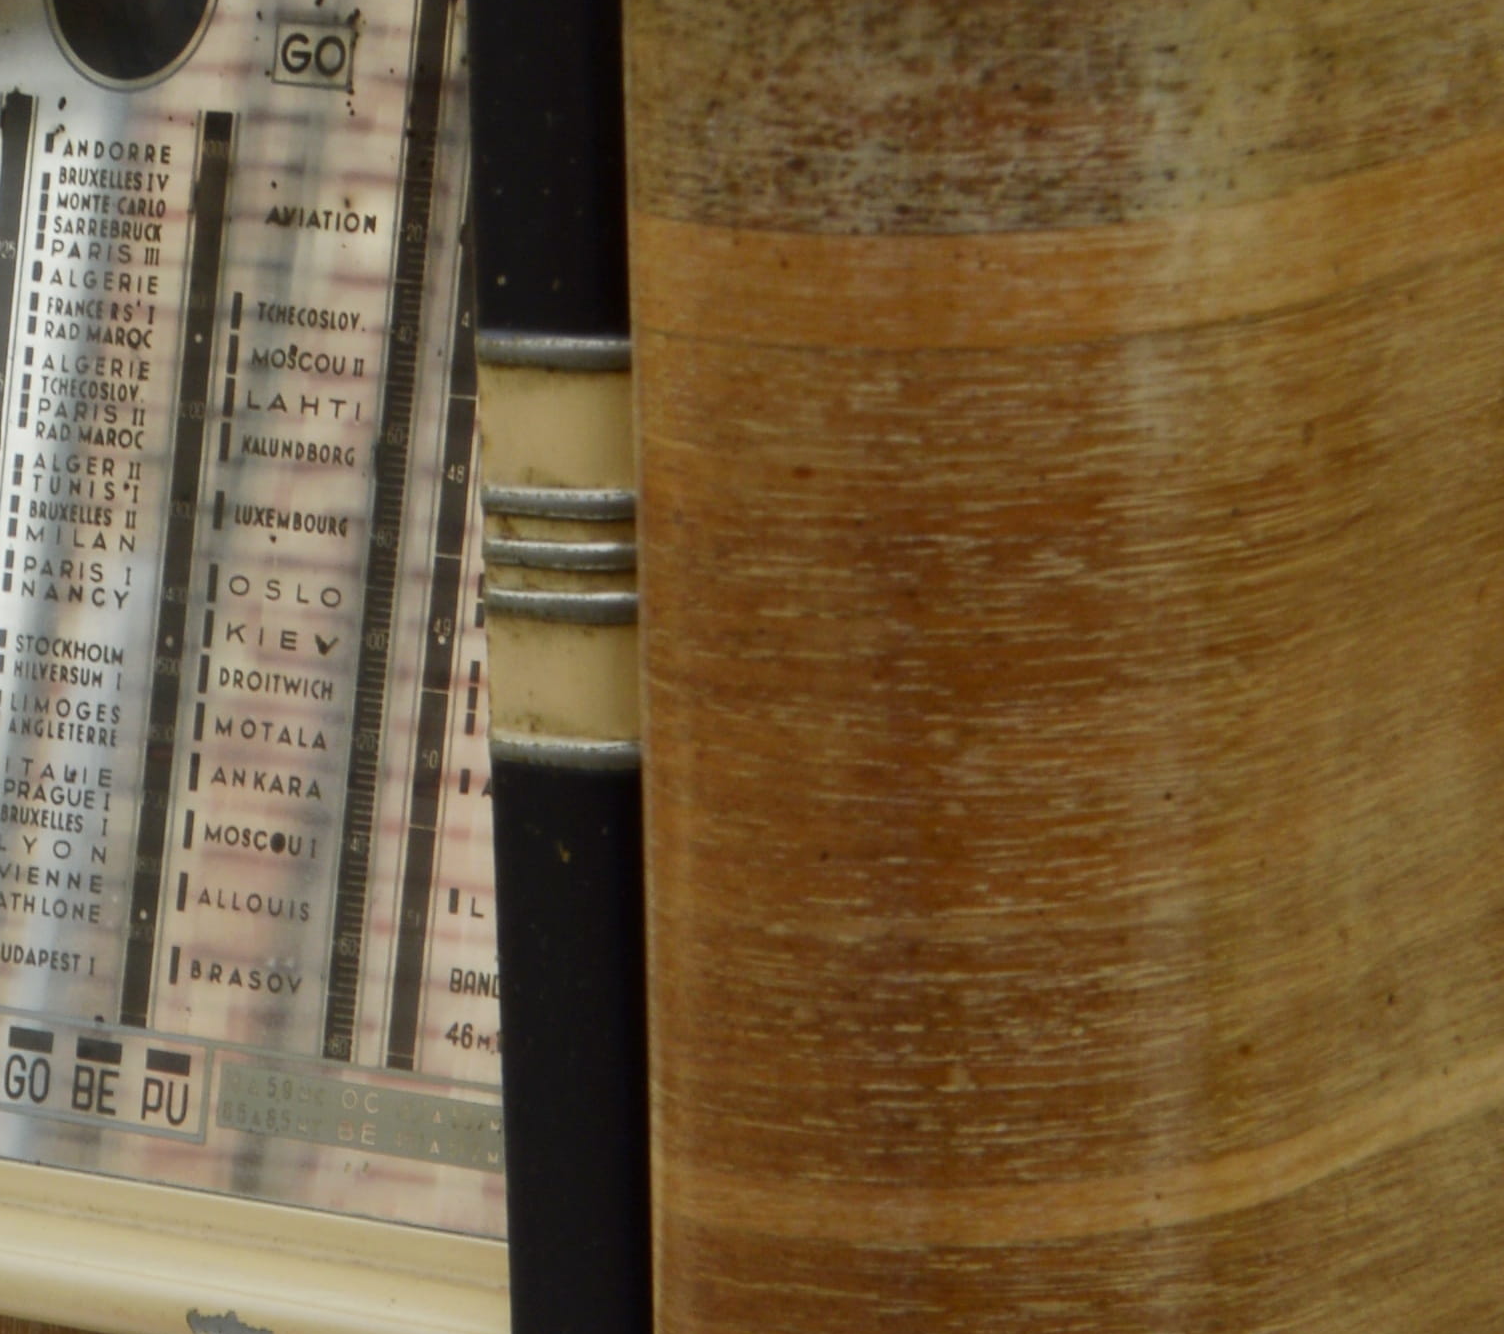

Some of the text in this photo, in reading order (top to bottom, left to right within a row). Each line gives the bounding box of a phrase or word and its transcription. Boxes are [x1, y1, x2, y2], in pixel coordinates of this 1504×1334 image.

[280, 32, 346, 76] GO
[63, 138, 171, 164] ANDORRE
[59, 165, 169, 191] BRUXELLES IV
[57, 192, 166, 218] MONTE CARLO
[265, 204, 377, 234] AVIATION
[54, 217, 162, 243] SARREBRUCK
[51, 240, 132, 264] PARIS
[50, 270, 159, 295] ALGERIE
[47, 297, 102, 318] FRANCE
[257, 301, 366, 333] TCHECOSLOV.
[44, 321, 153, 349] RAD MAROC
[42, 354, 150, 381] ALGERIE
[252, 347, 345, 378] MOSCOU
[38, 399, 118, 425] PARIS
[247, 390, 362, 421] LAHTI
[35, 421, 144, 449] RAD MAROC
[33, 452, 114, 476] ALGER
[242, 434, 355, 467] KALUNDBORG
[33, 474, 115, 501] TUNIS
[447, 464, 465, 484] 48
[29, 500, 113, 526] BRUXELLES
[234, 503, 348, 538] LUXEMBOURG
[26, 526, 137, 553] MILAN
[24, 555, 104, 582] PARIS
[21, 580, 129, 608] NANCY
[228, 574, 342, 608] OSLO
[16, 634, 124, 665] STOCKHOLM
[226, 622, 339, 656] KIEV
[14, 660, 102, 689] HILVERSUM
[219, 666, 333, 701] DROITWICH
[10, 692, 121, 725] LIMOGES
[8, 717, 118, 747] ANGLETERRE
[214, 717, 327, 750] MOTALA
[4, 756, 112, 788] ITALIE
[210, 766, 322, 800] ANKARA
[3, 779, 96, 809] PRAGUE
[1, 803, 84, 834] BRUXELLES
[198, 888, 311, 922] ALLOUIS
[190, 959, 304, 995] BRASOV
[445, 1022, 474, 1049] 46
[5, 1054, 51, 1104] GO
[71, 1065, 120, 1116] BE
[141, 1077, 190, 1126] PU
[342, 1089, 380, 1114] OC
